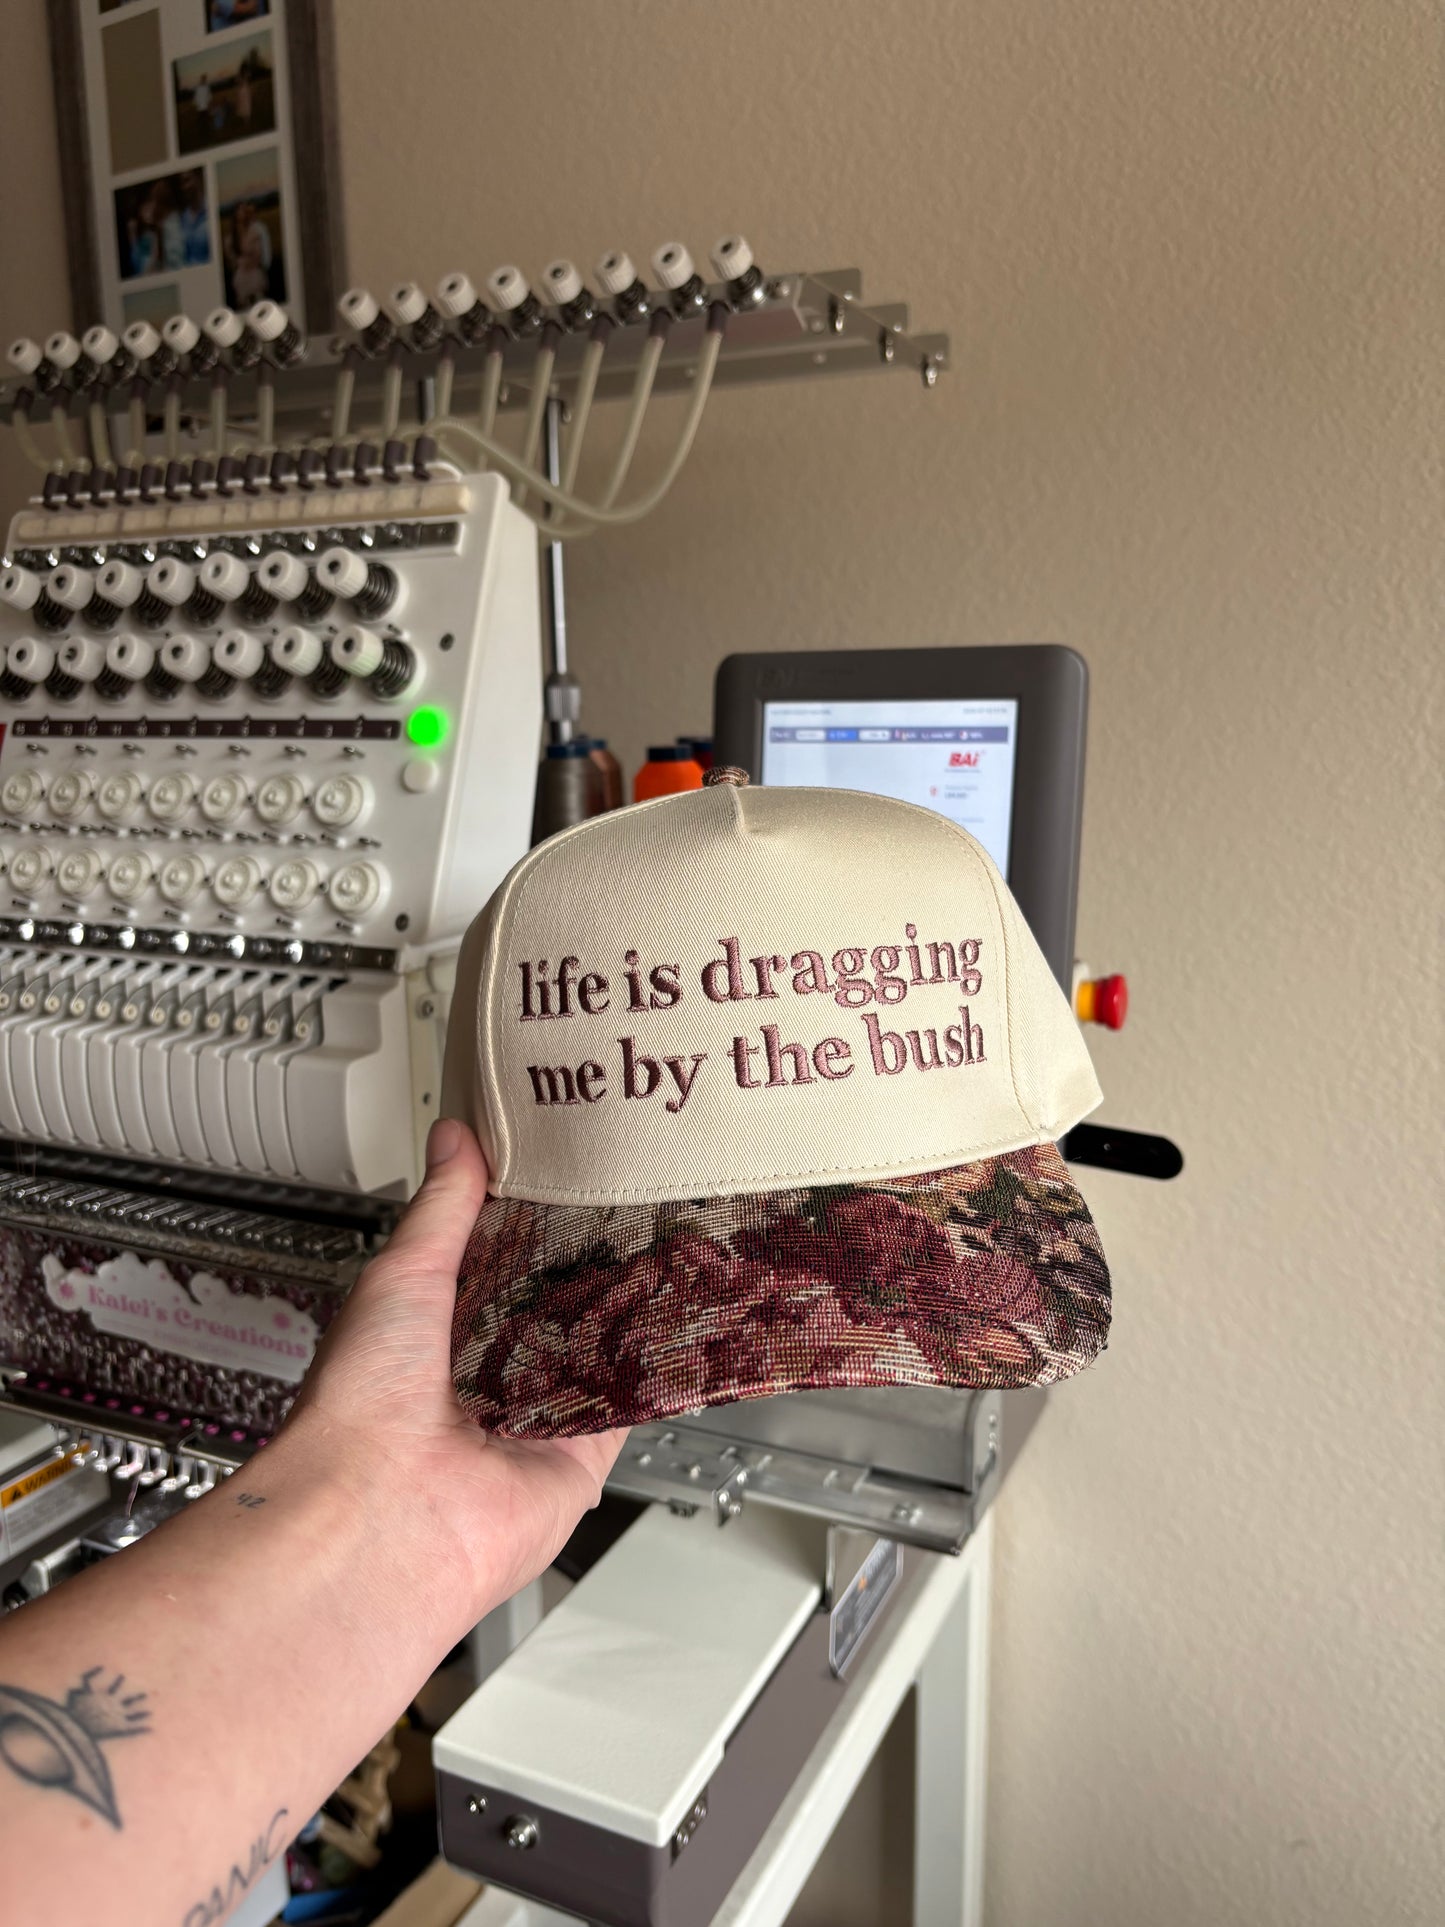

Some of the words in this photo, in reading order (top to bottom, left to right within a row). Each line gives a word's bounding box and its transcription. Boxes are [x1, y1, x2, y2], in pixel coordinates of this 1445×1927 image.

[518, 954, 611, 1022] life
[623, 949, 683, 1013] is
[700, 922, 983, 1008] dragging
[526, 1059, 607, 1106] me
[618, 1035, 708, 1113] by
[727, 1024, 855, 1088] the
[861, 1005, 987, 1076] bush
[174, 1307, 308, 1359] Creations
